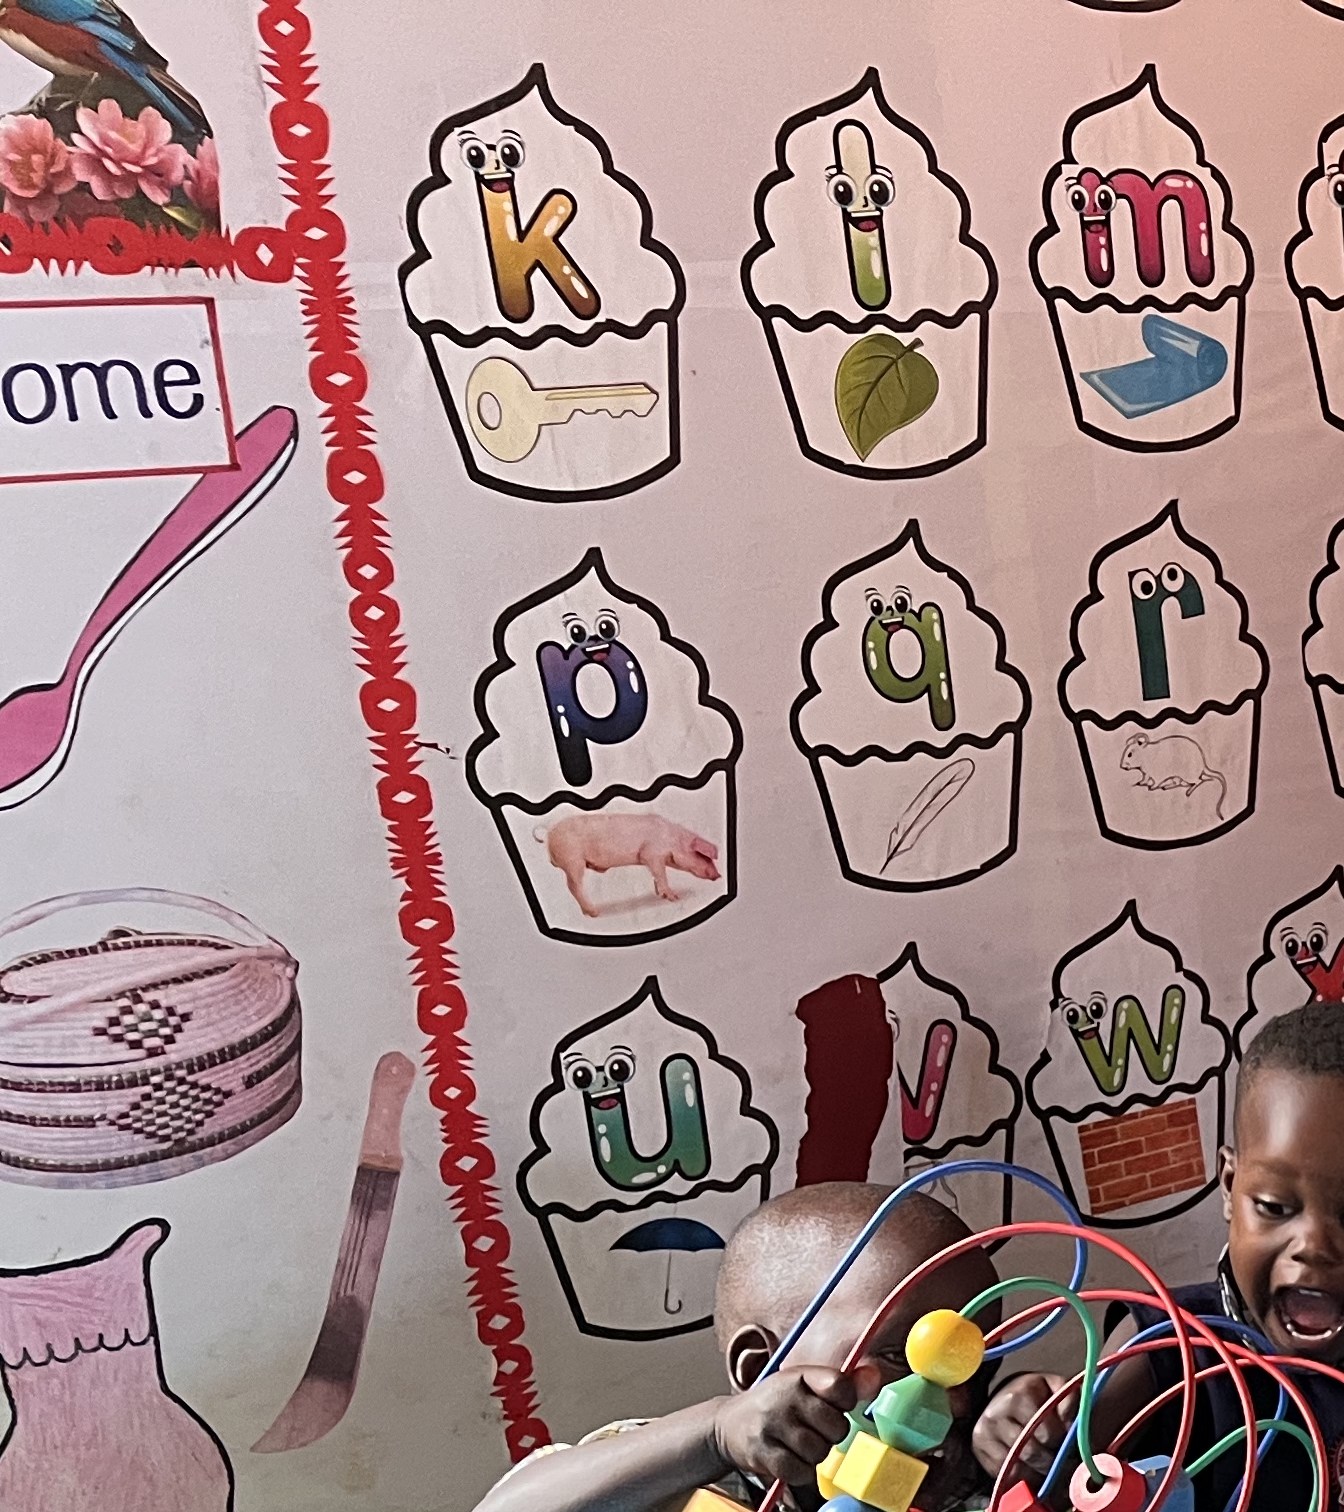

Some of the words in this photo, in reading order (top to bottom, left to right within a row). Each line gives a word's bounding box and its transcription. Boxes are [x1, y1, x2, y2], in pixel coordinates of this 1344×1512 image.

[474, 142, 603, 324] k
[1074, 167, 1216, 290] m
[535, 630, 649, 787] p
[861, 600, 956, 731] q
